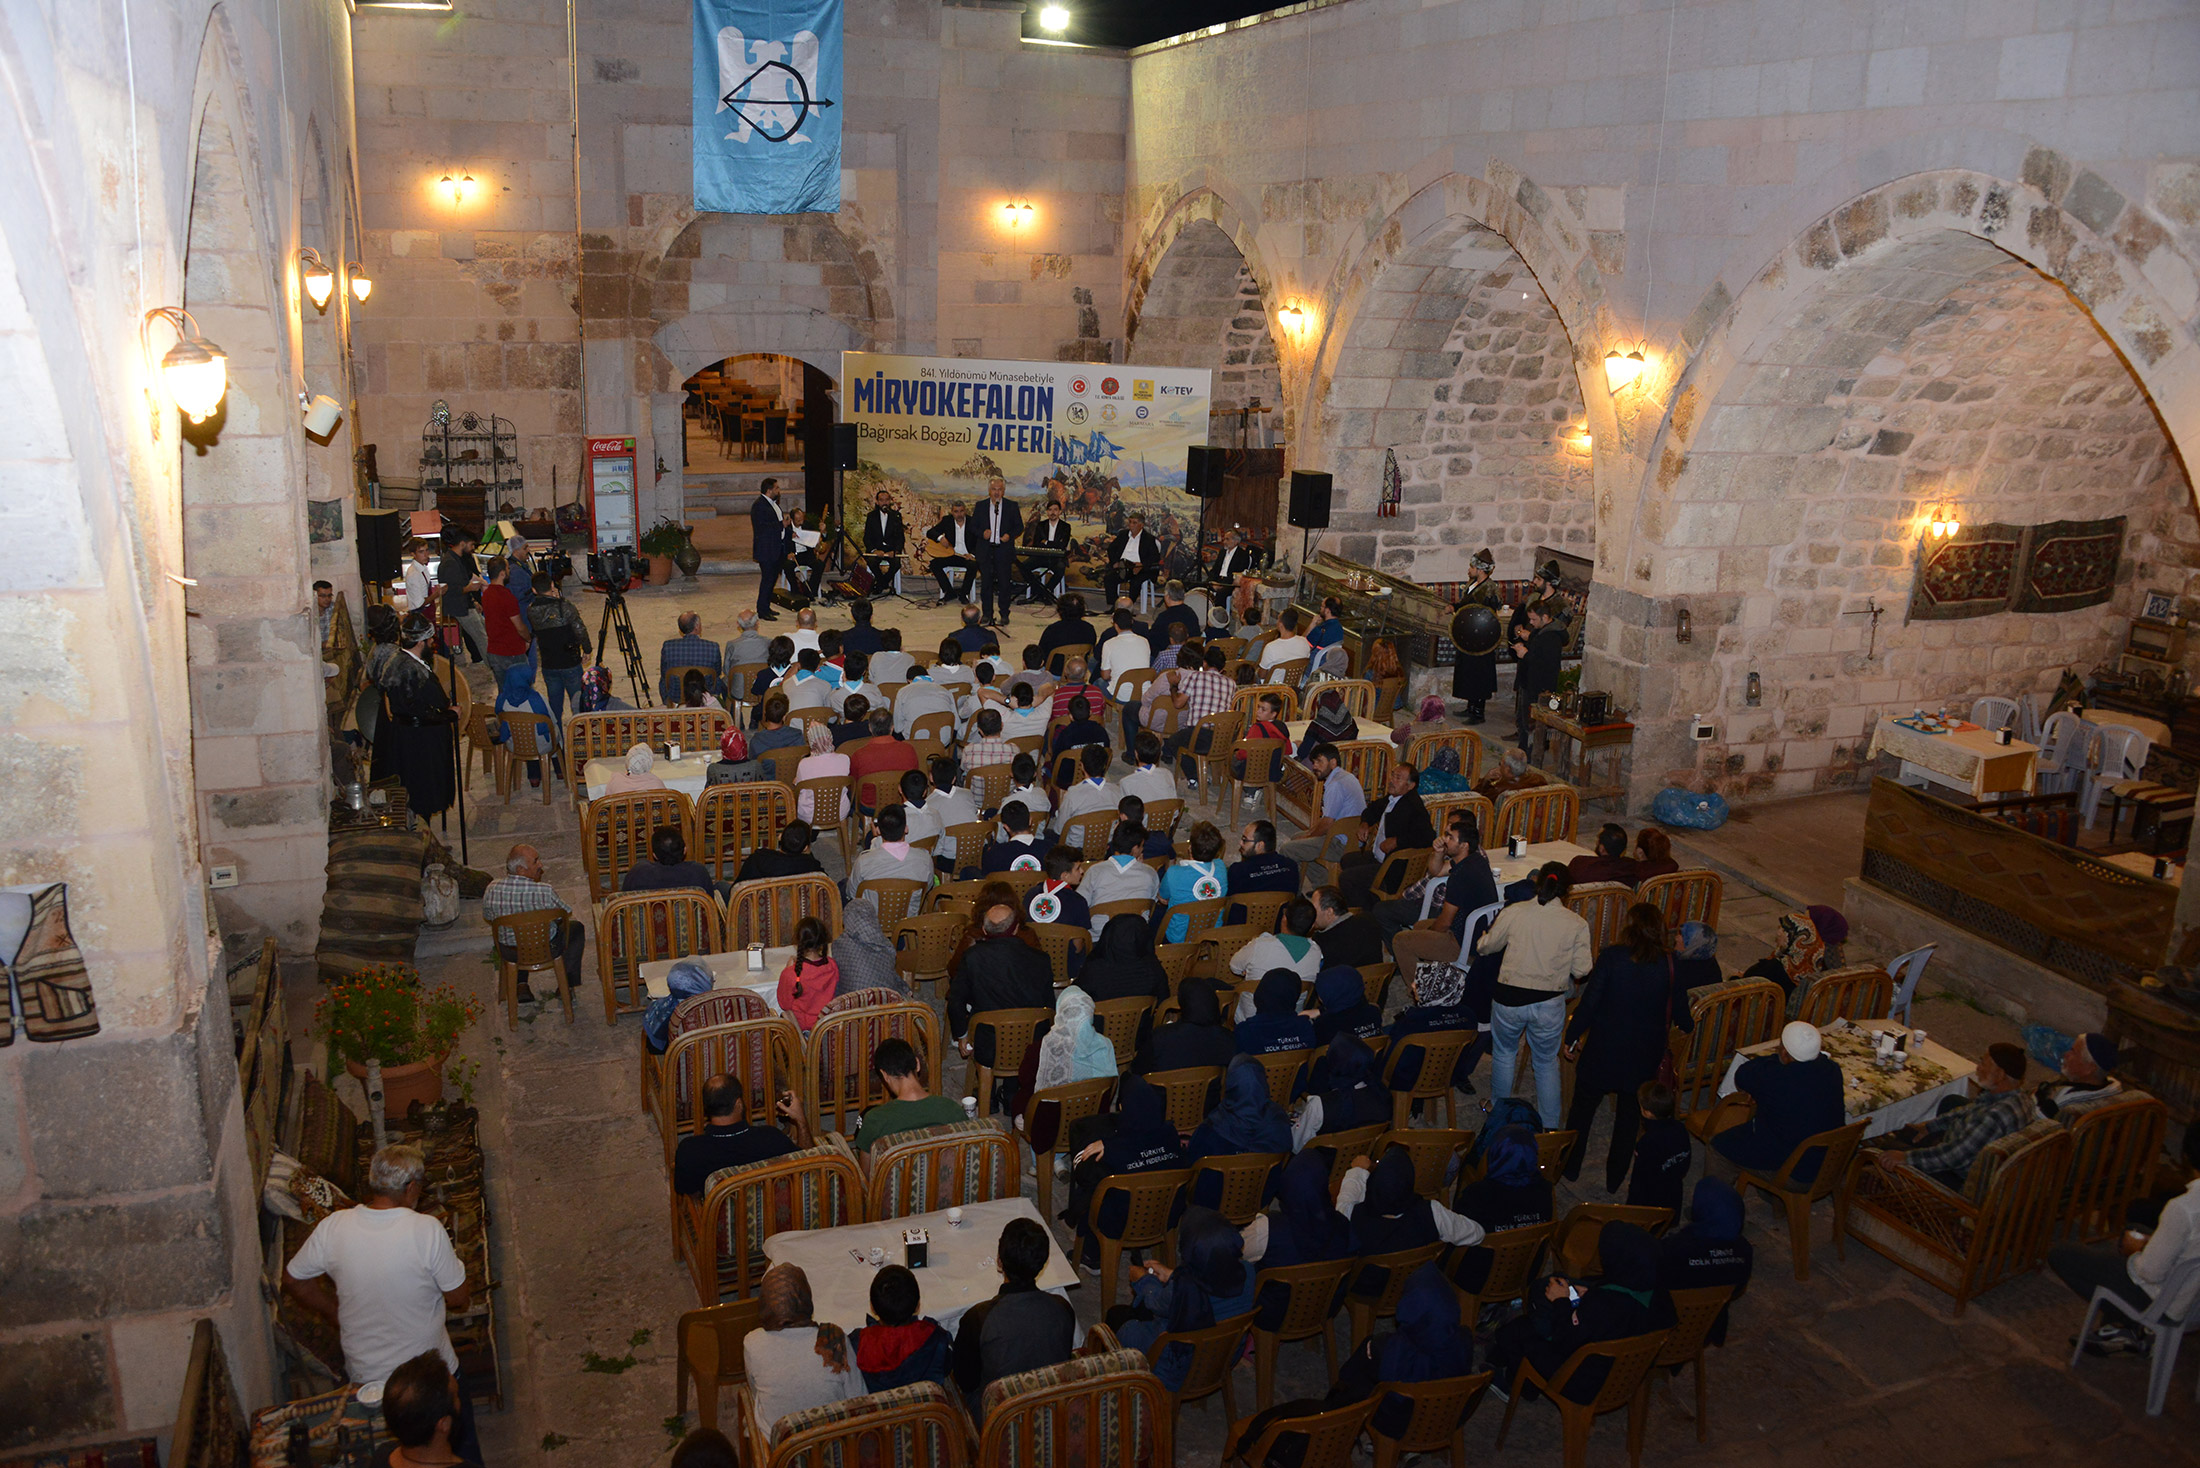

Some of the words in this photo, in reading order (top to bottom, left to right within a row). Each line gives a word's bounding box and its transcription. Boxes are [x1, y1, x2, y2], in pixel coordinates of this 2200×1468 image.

[920, 367, 936, 379] 841.
[939, 368, 987, 380] Yıldönümü
[989, 370, 1055, 385] Münasebetiyle
[854, 370, 1054, 422] MİRYOKEFALON
[921, 425, 971, 446] Boğazı)
[976, 422, 1053, 454] ZAFERİ
